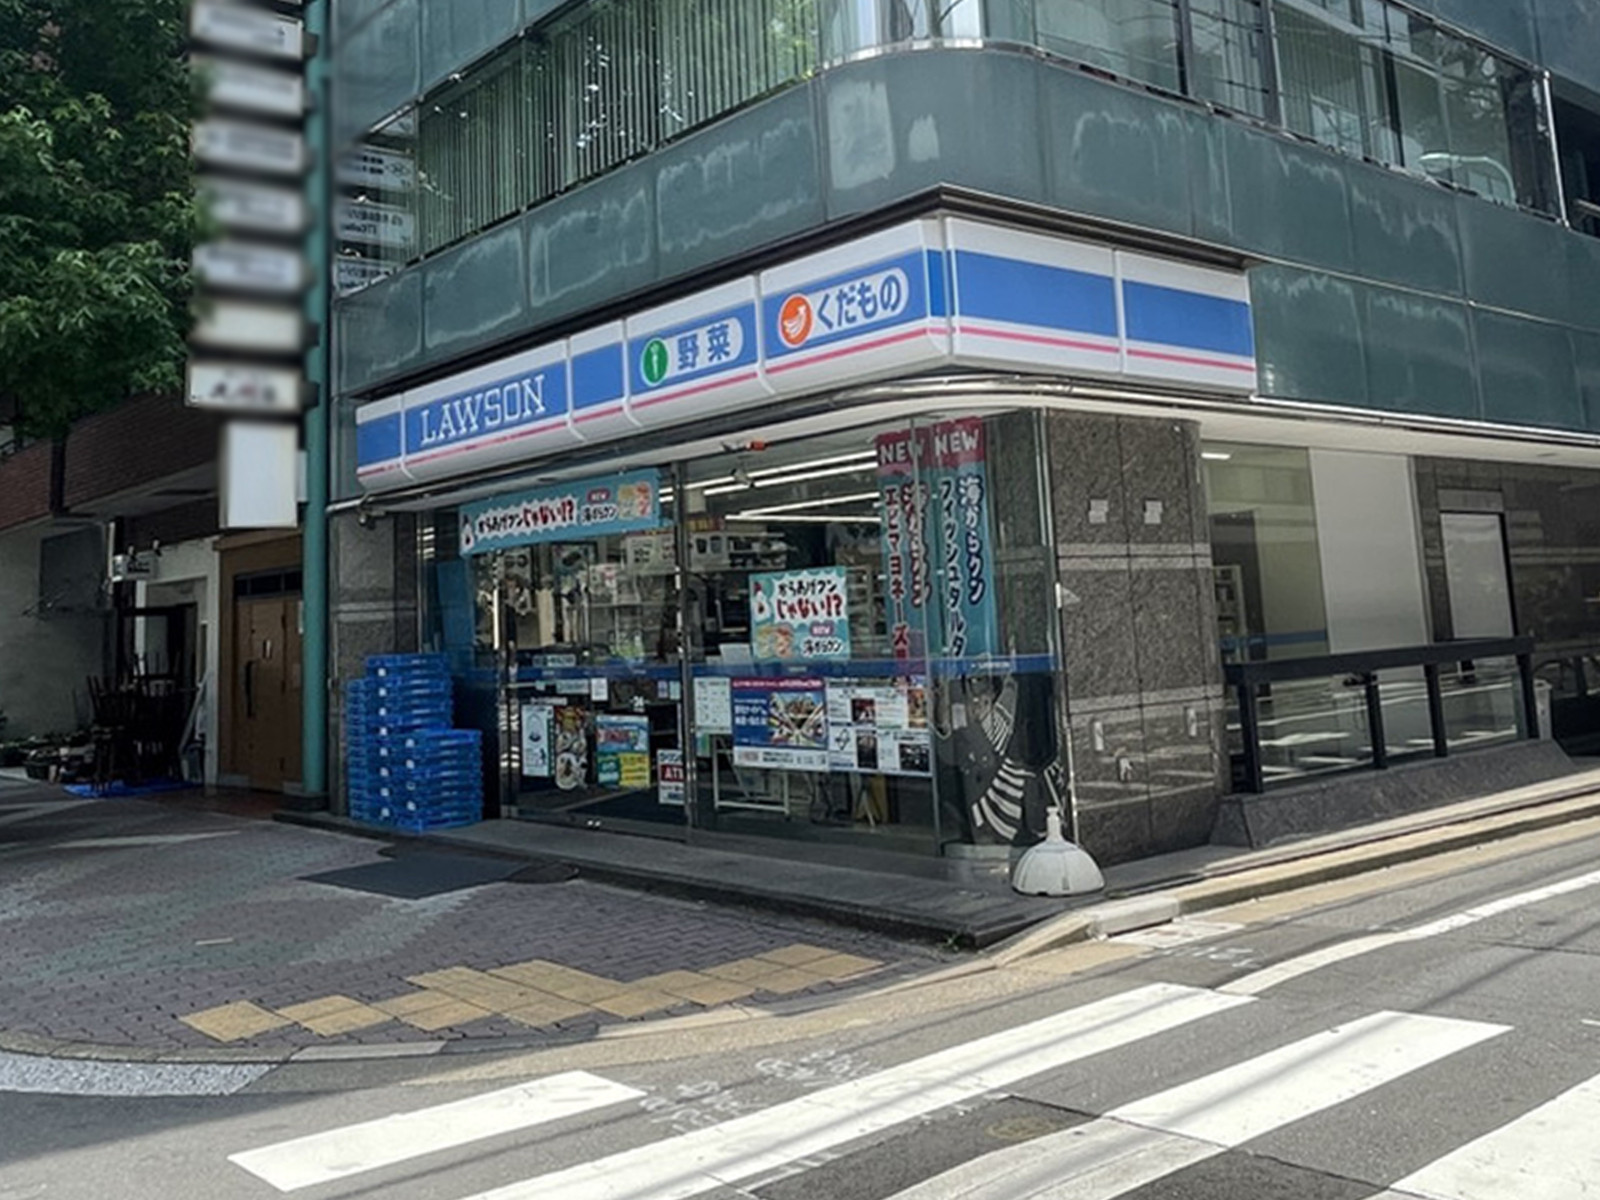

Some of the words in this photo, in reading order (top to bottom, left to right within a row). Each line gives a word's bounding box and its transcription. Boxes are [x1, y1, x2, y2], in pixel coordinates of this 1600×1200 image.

[816, 274, 901, 329] くだもの
[677, 323, 731, 371] 野菜
[421, 374, 546, 445] LAWSON
[879, 439, 925, 464] NEW
[934, 428, 979, 457] NEW
